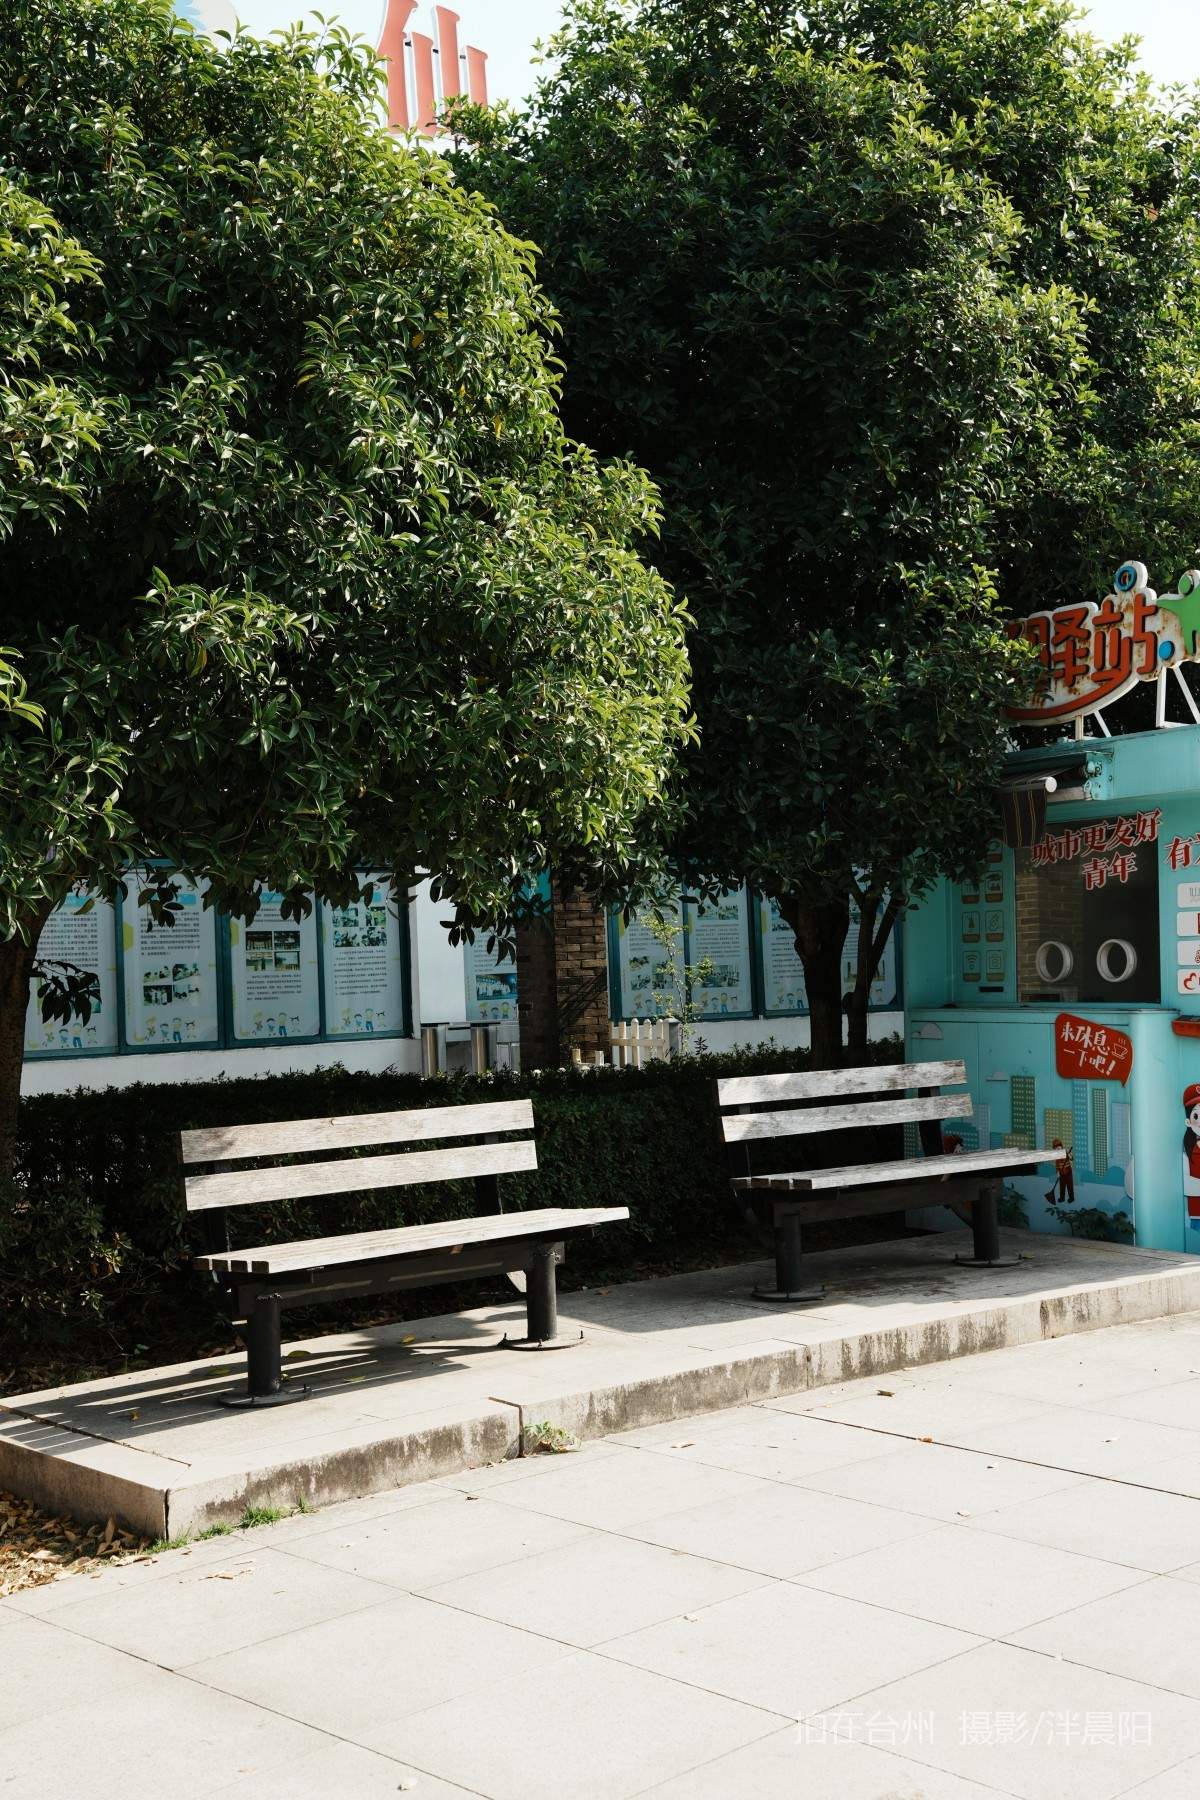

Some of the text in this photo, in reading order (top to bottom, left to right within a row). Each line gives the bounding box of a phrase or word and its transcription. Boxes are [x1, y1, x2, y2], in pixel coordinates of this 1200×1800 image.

[1031, 808, 1163, 868] 城市更友好
[1164, 832, 1200, 872] 有
[1082, 852, 1138, 890] 青年
[1060, 1021, 1110, 1056] 来休息
